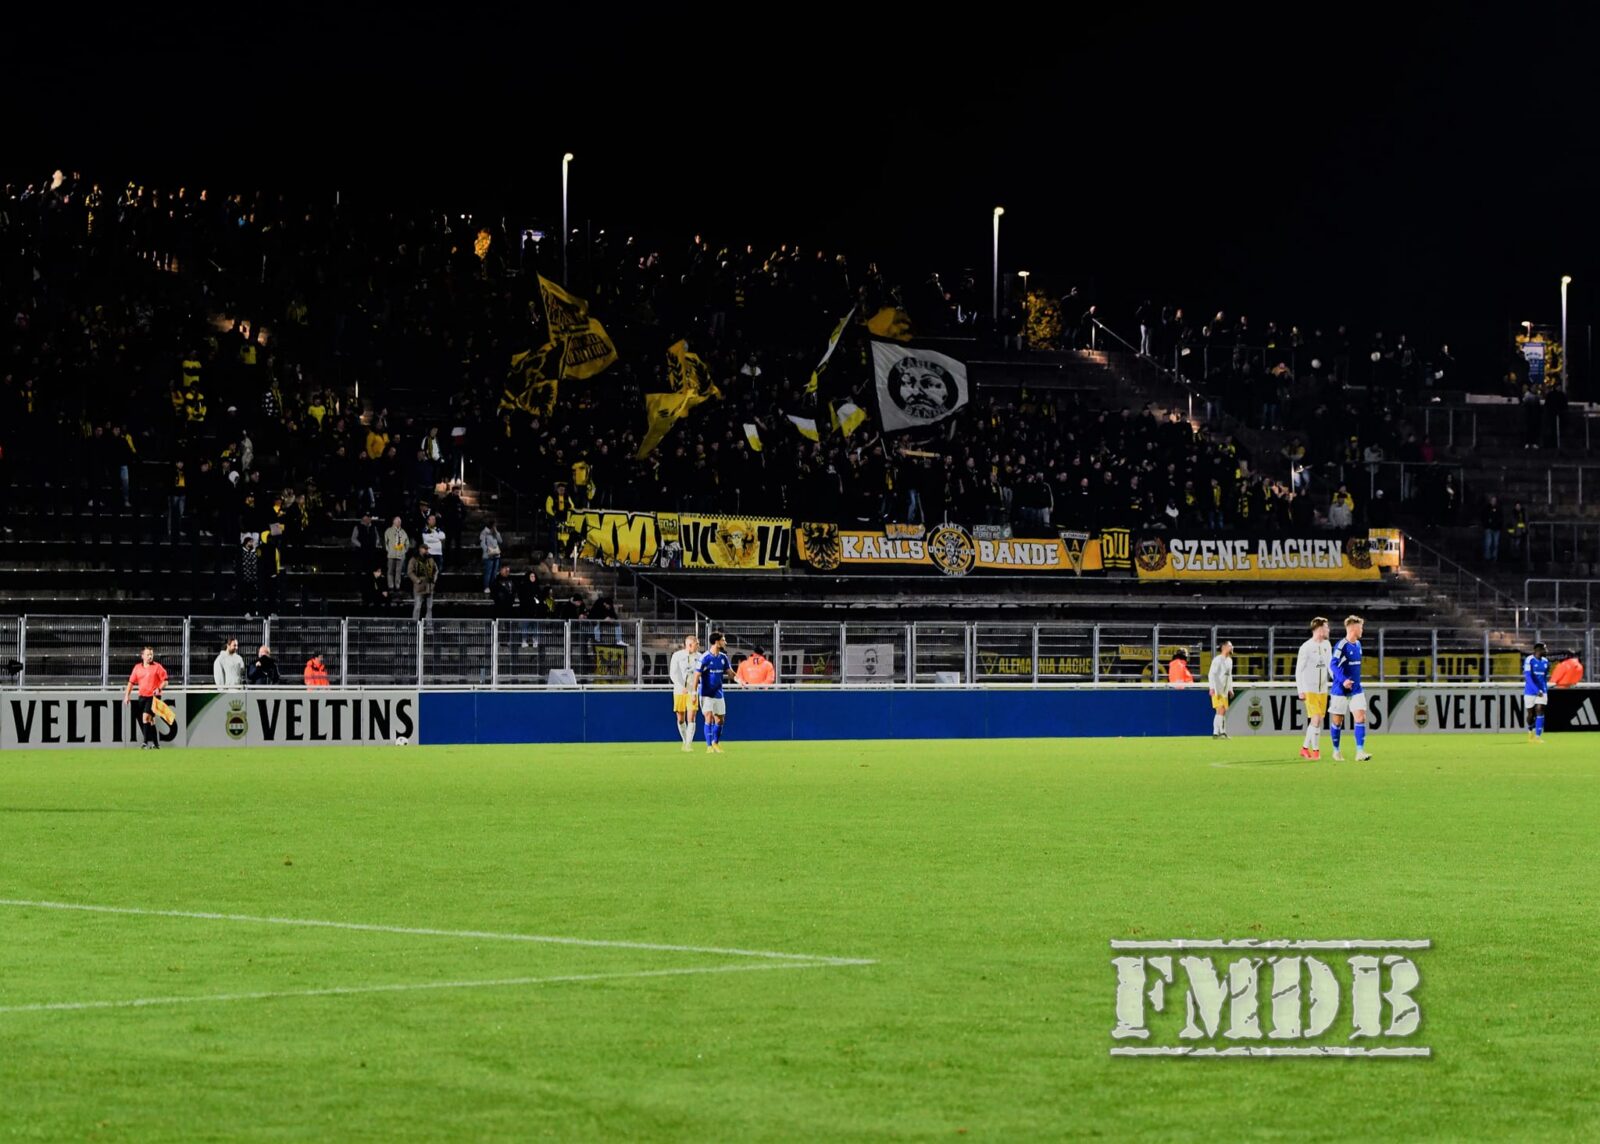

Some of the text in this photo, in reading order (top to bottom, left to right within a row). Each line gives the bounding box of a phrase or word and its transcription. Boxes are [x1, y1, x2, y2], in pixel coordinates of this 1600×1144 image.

[840, 536, 1059, 565] KARLS BANDE
[1169, 538, 1343, 571] SZENE AACHEN
[256, 698, 414, 741] VELTINS
[1434, 694, 1525, 729] VELTIN
